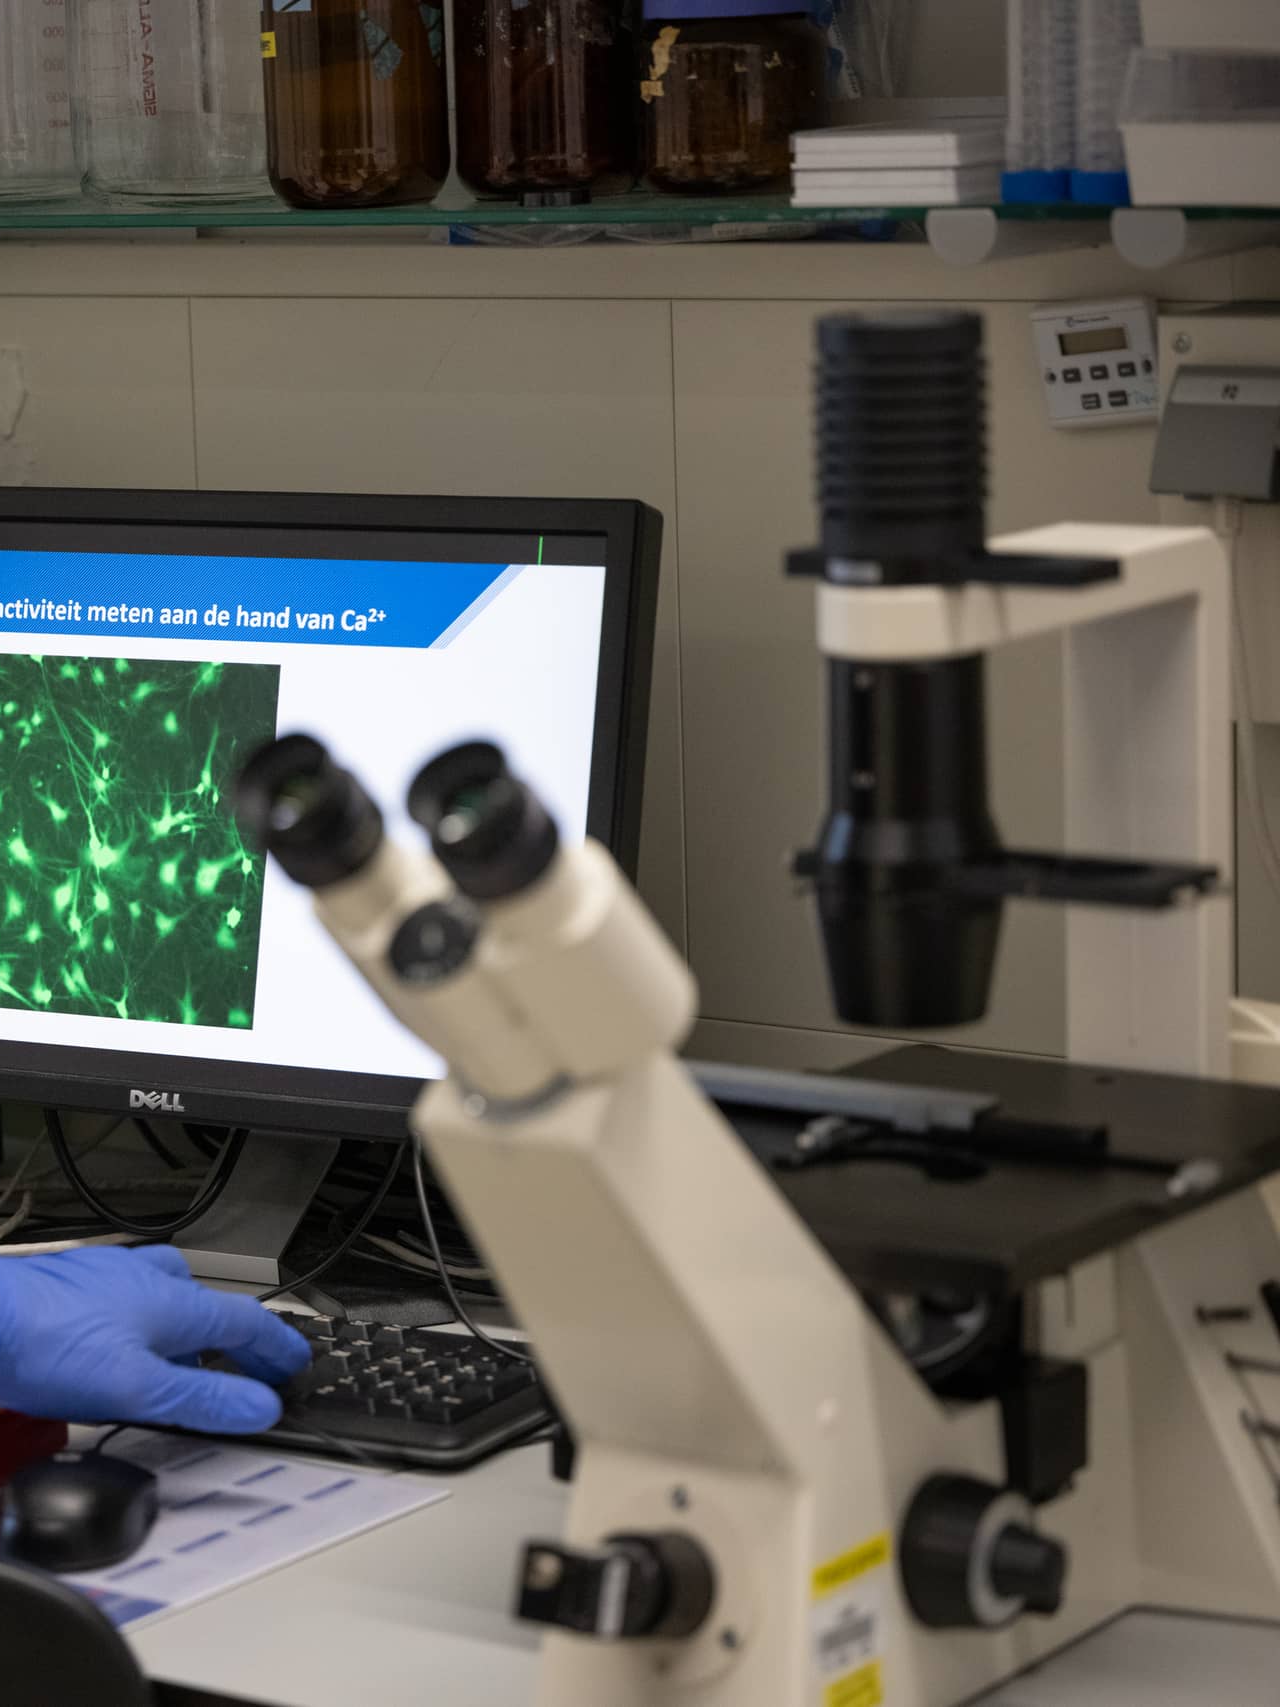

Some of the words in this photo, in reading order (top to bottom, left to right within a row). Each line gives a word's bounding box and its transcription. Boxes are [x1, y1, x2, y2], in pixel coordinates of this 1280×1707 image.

[87, 603, 154, 624] meten
[159, 607, 198, 626] aan
[203, 603, 231, 627] de
[235, 604, 291, 629] hand
[295, 611, 335, 631] van
[129, 1089, 185, 1113] DELL
